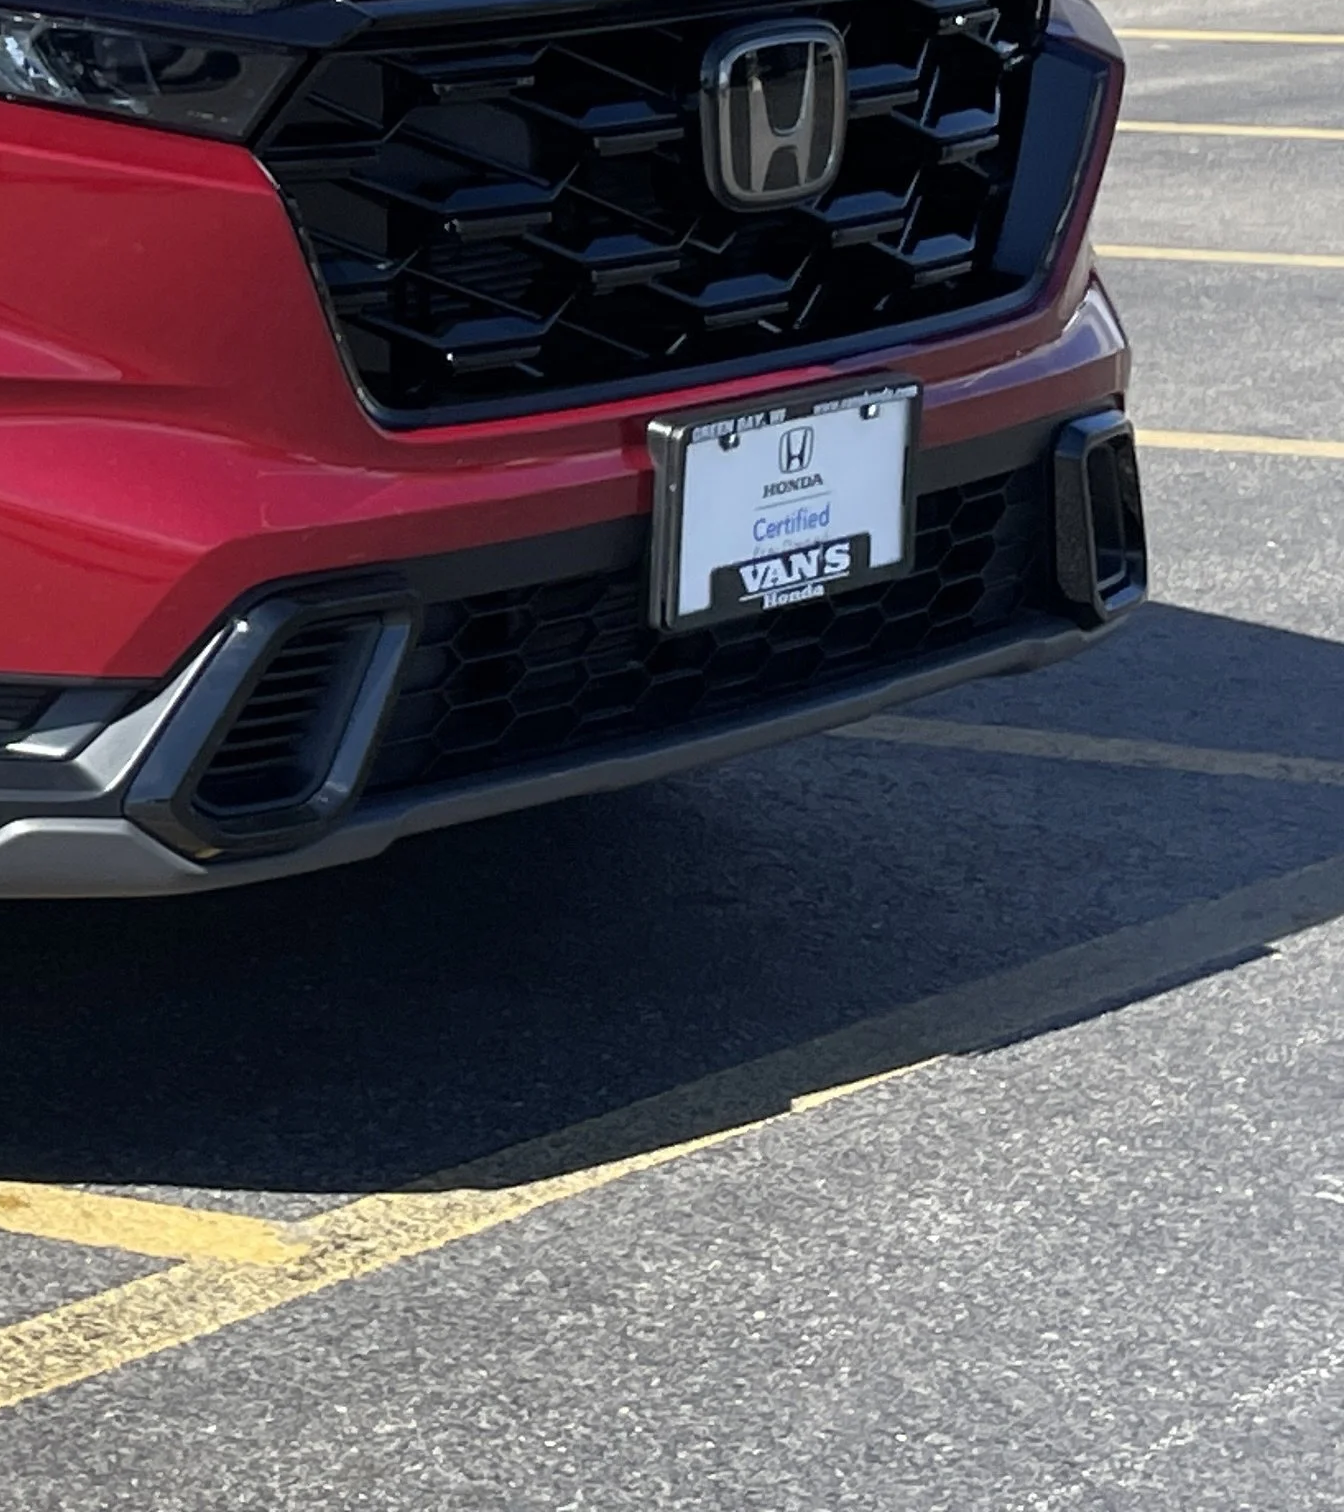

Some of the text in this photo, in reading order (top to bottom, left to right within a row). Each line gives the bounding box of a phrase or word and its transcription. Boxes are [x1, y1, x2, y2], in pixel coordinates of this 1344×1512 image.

[762, 473, 824, 499] HONDA
[753, 503, 830, 541] Certified
[763, 582, 825, 610] Honda
